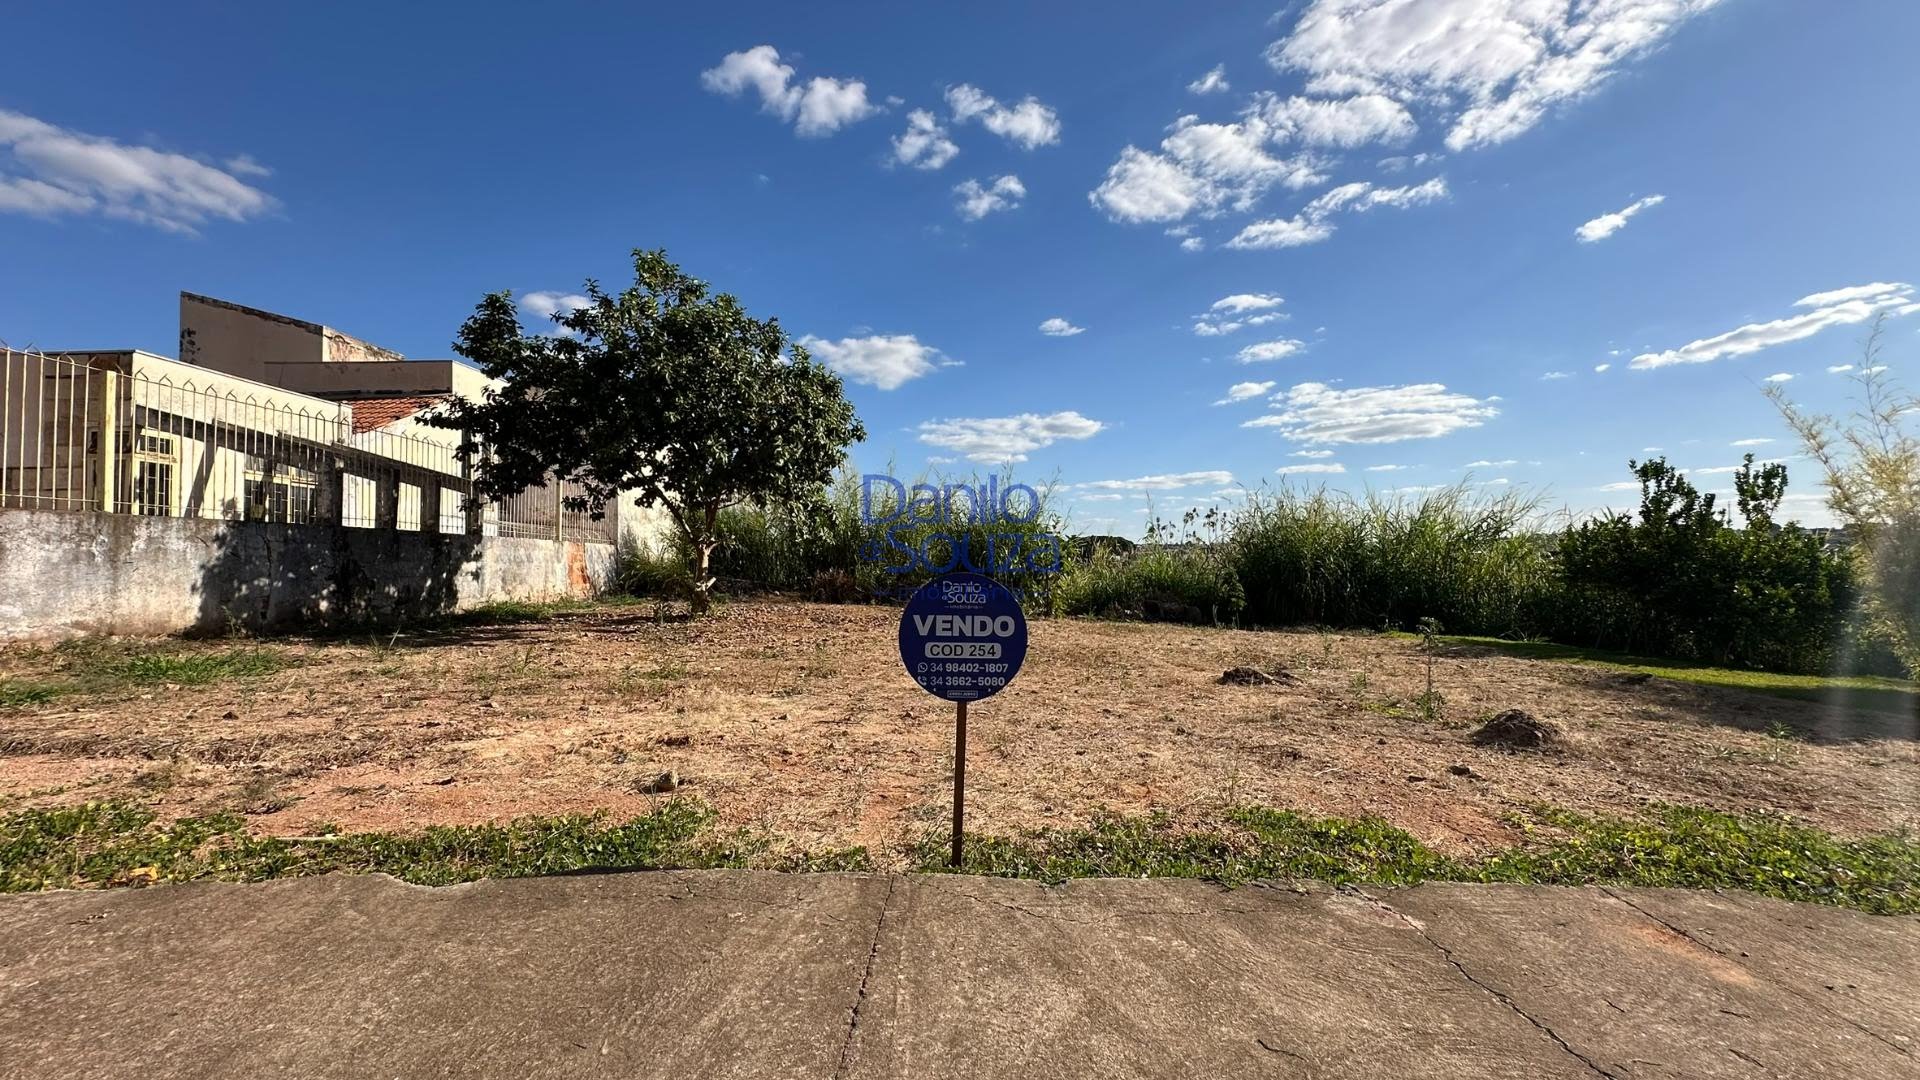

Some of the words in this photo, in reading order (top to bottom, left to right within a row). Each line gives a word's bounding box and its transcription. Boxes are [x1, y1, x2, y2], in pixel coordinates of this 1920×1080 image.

[942, 580, 982, 593] Danilo
[947, 591, 987, 604] Souza
[912, 614, 1016, 637] VENDO
[929, 644, 964, 657] COD
[968, 644, 997, 657] 254
[930, 663, 944, 673] 34
[945, 663, 1009, 673] 98402-1807
[930, 676, 944, 686] 34
[945, 676, 1006, 687] 3662-5080
